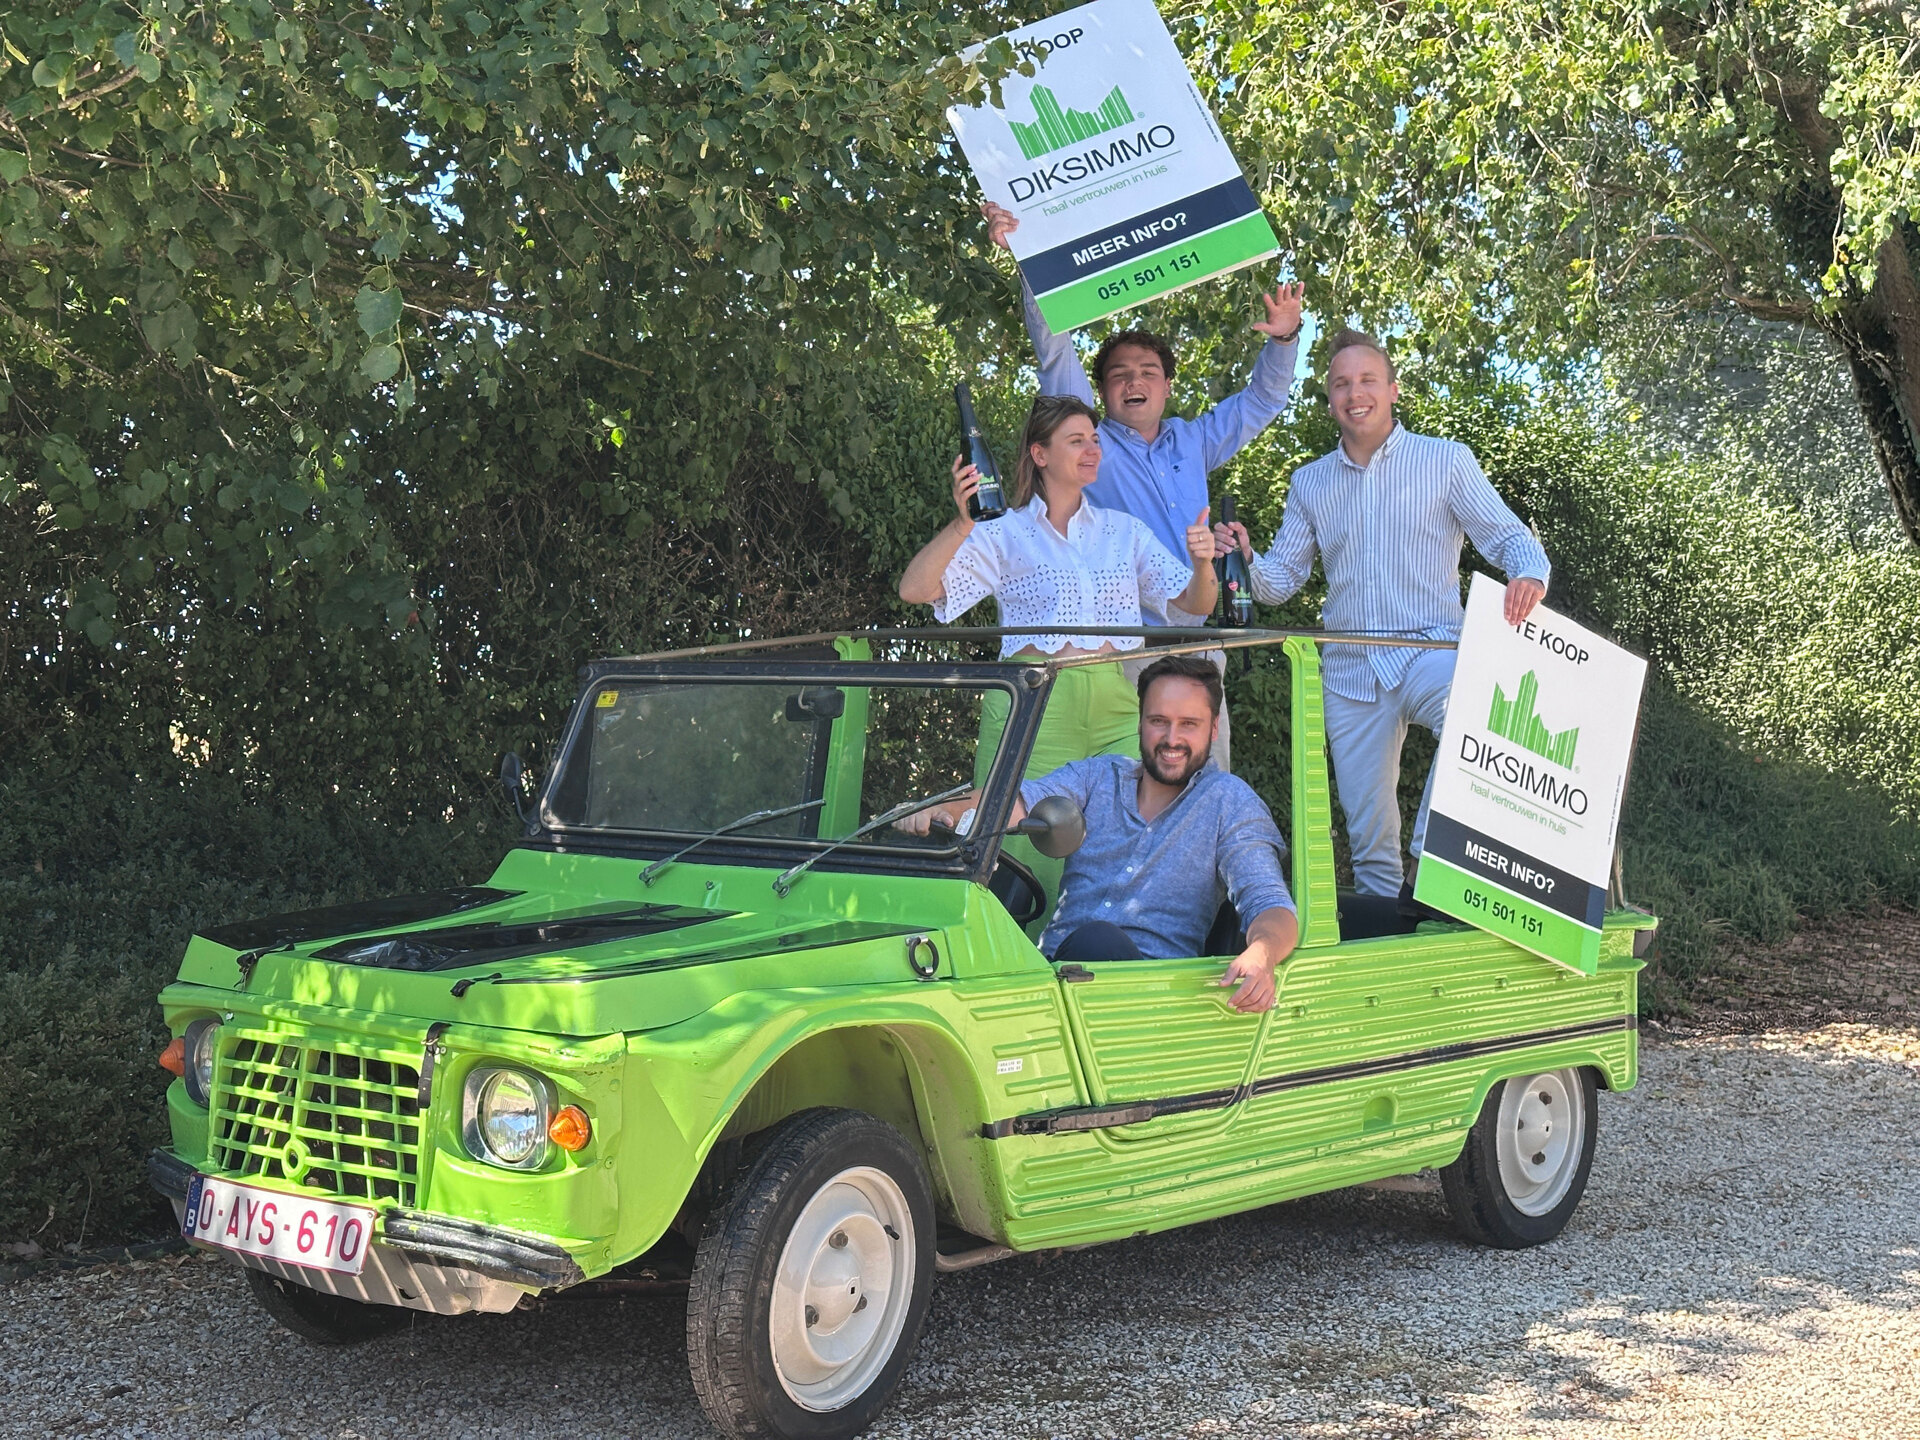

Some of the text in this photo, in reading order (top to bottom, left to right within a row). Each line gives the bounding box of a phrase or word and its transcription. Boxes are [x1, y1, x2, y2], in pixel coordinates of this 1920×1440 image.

[1007, 124, 1175, 203] DIKSIMMO
[1042, 164, 1168, 217] haal vertrouwen in huis
[1072, 212, 1187, 266] MEER INFO?
[1097, 250, 1201, 300] 051 501 151
[1540, 629, 1589, 665] KOOP
[1460, 733, 1588, 815] DIKSIMMO
[1470, 781, 1567, 836] haal vertrouwen in huis
[1465, 840, 1555, 894] MEER INFO?
[1463, 889, 1544, 937] 051 501 151
[186, 1209, 196, 1227] B
